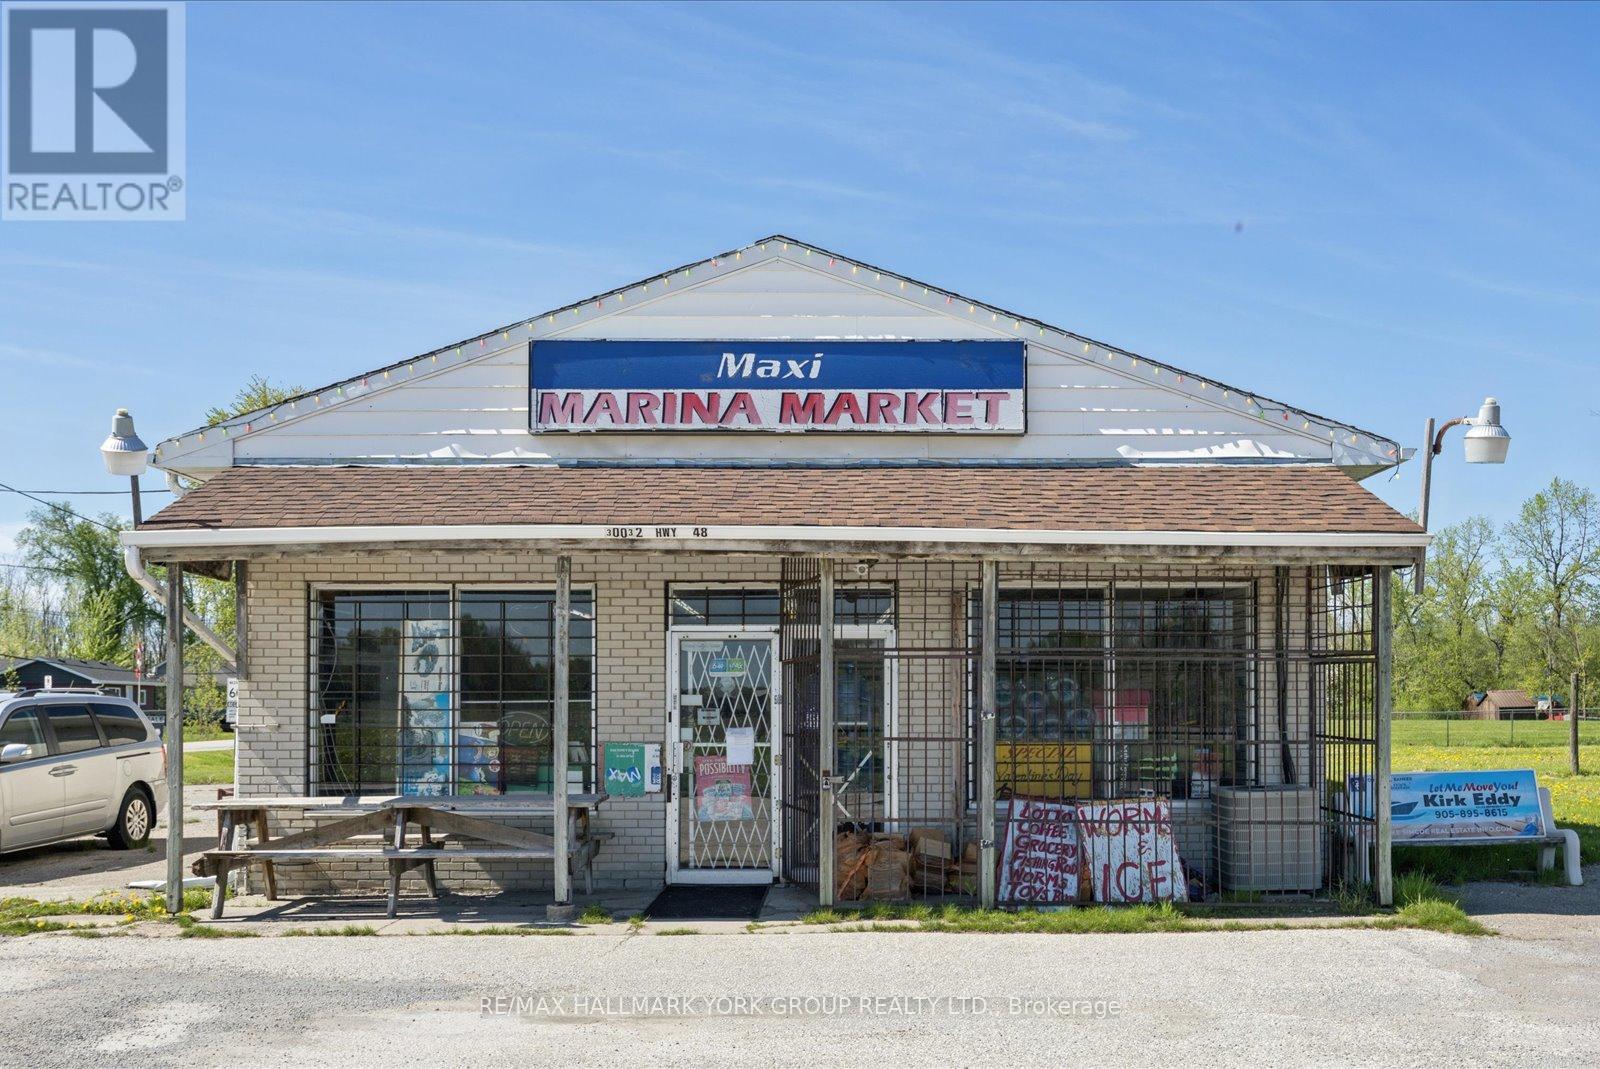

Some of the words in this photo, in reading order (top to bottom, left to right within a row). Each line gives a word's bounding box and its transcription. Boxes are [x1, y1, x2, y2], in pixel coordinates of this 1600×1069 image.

[717, 352, 824, 379] Maxi
[538, 392, 763, 424] MARINA
[779, 392, 1011, 425] MARKET
[606, 527, 643, 538] 30032
[655, 527, 677, 538] HWY
[693, 527, 708, 538] 48
[1462, 782, 1494, 792] Move
[1493, 781, 1519, 793] You!
[1423, 794, 1467, 808] Kirk
[1472, 792, 1521, 808] Eddy
[1434, 808, 1508, 819] 905-895-8615
[1102, 860, 1174, 902] ICE
